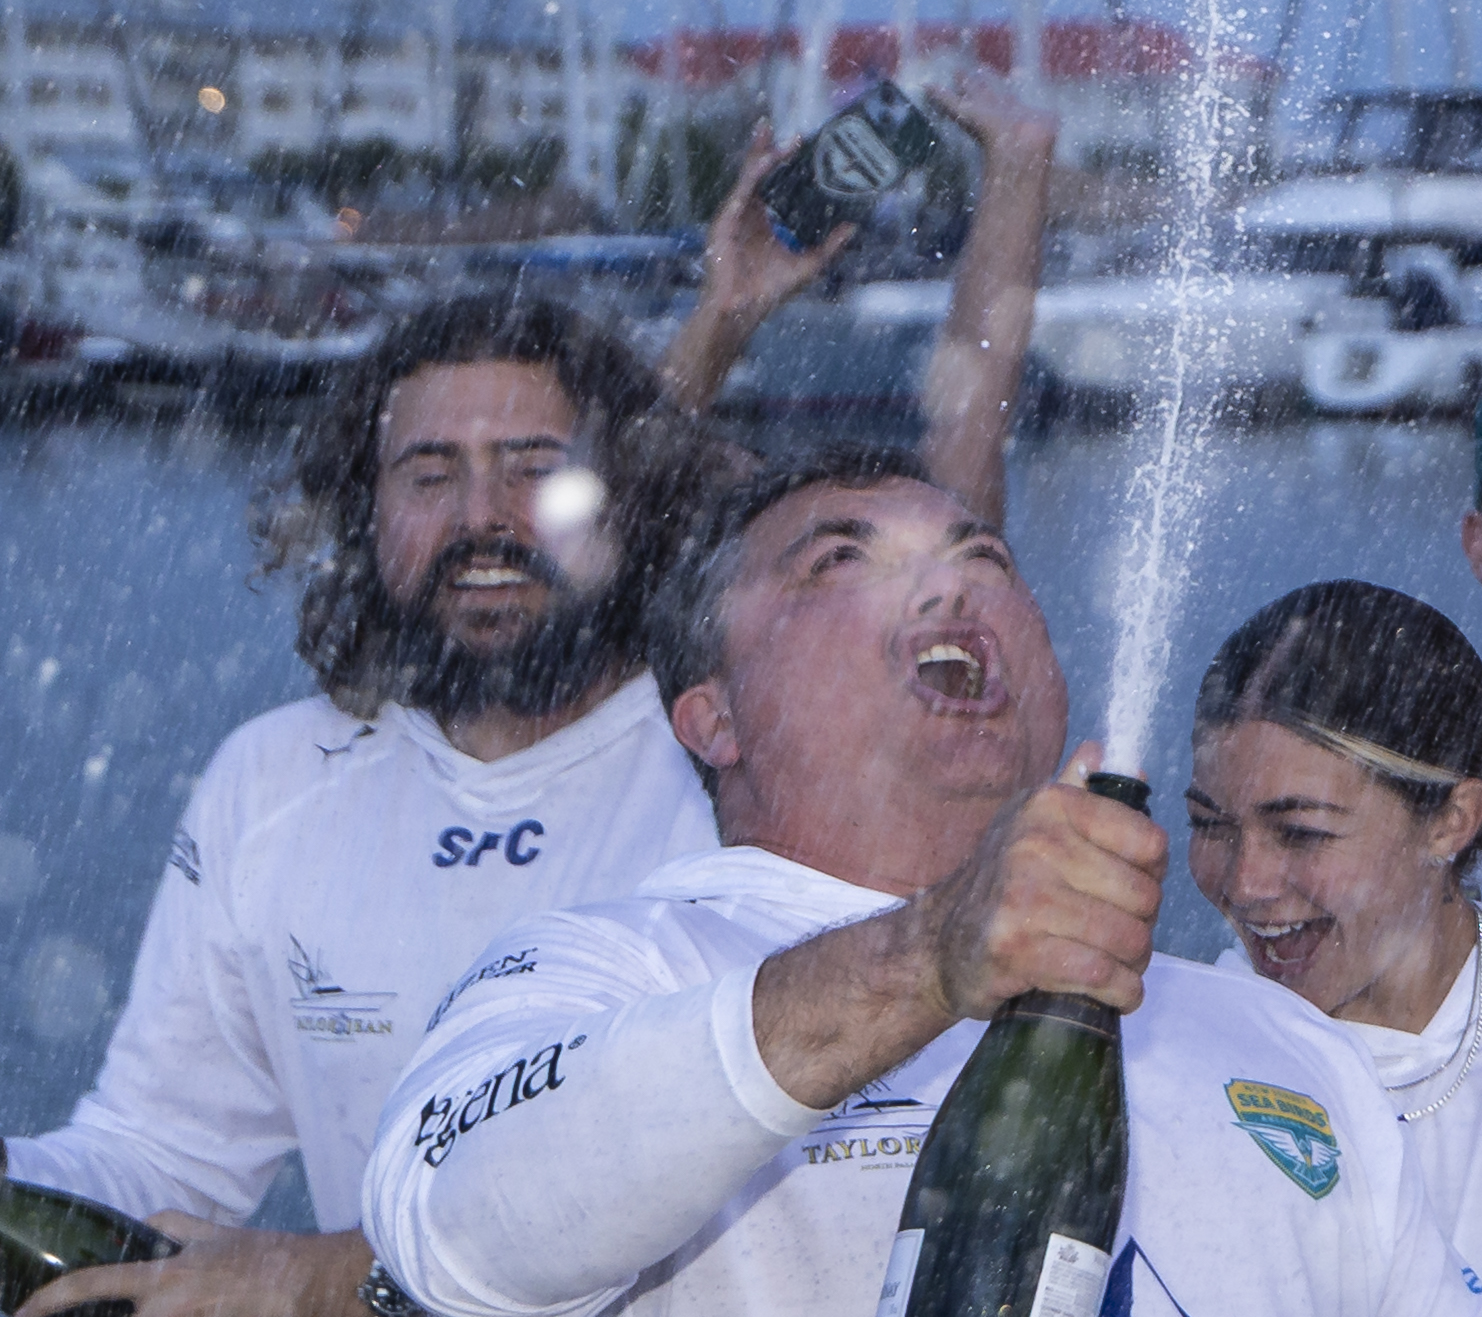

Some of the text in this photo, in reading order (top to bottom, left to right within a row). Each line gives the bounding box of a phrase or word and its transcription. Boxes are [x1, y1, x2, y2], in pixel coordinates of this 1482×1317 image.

[1236, 1091, 1277, 1110] SEA
[1279, 1099, 1327, 1128] BIRDS
[802, 1135, 921, 1165] TAYLOR
